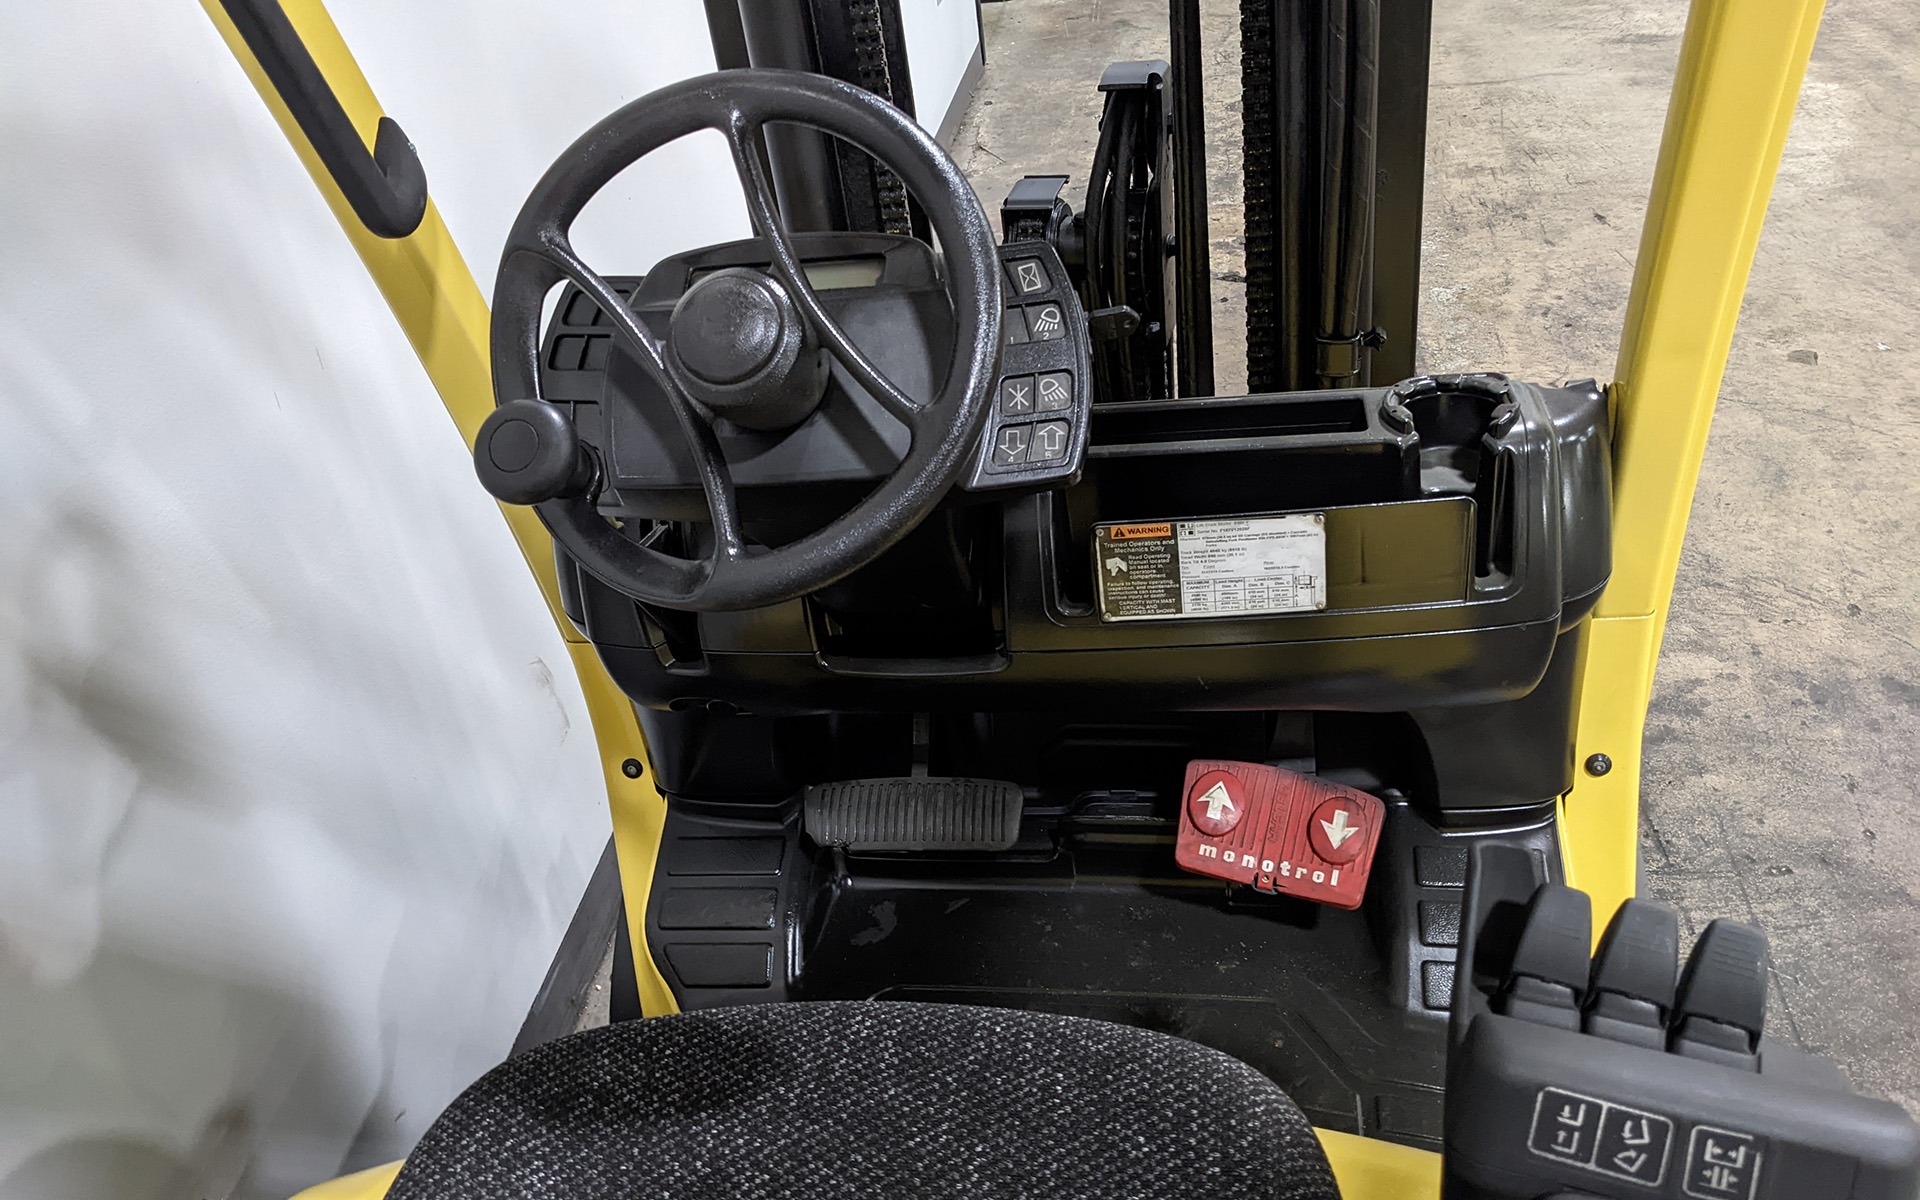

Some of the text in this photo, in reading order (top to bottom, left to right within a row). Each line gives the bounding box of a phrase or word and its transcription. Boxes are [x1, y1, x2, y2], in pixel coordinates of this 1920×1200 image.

[1043, 332, 1049, 340] 2
[1127, 526, 1169, 534] WARNING
[1199, 842, 1340, 886] monotrol
